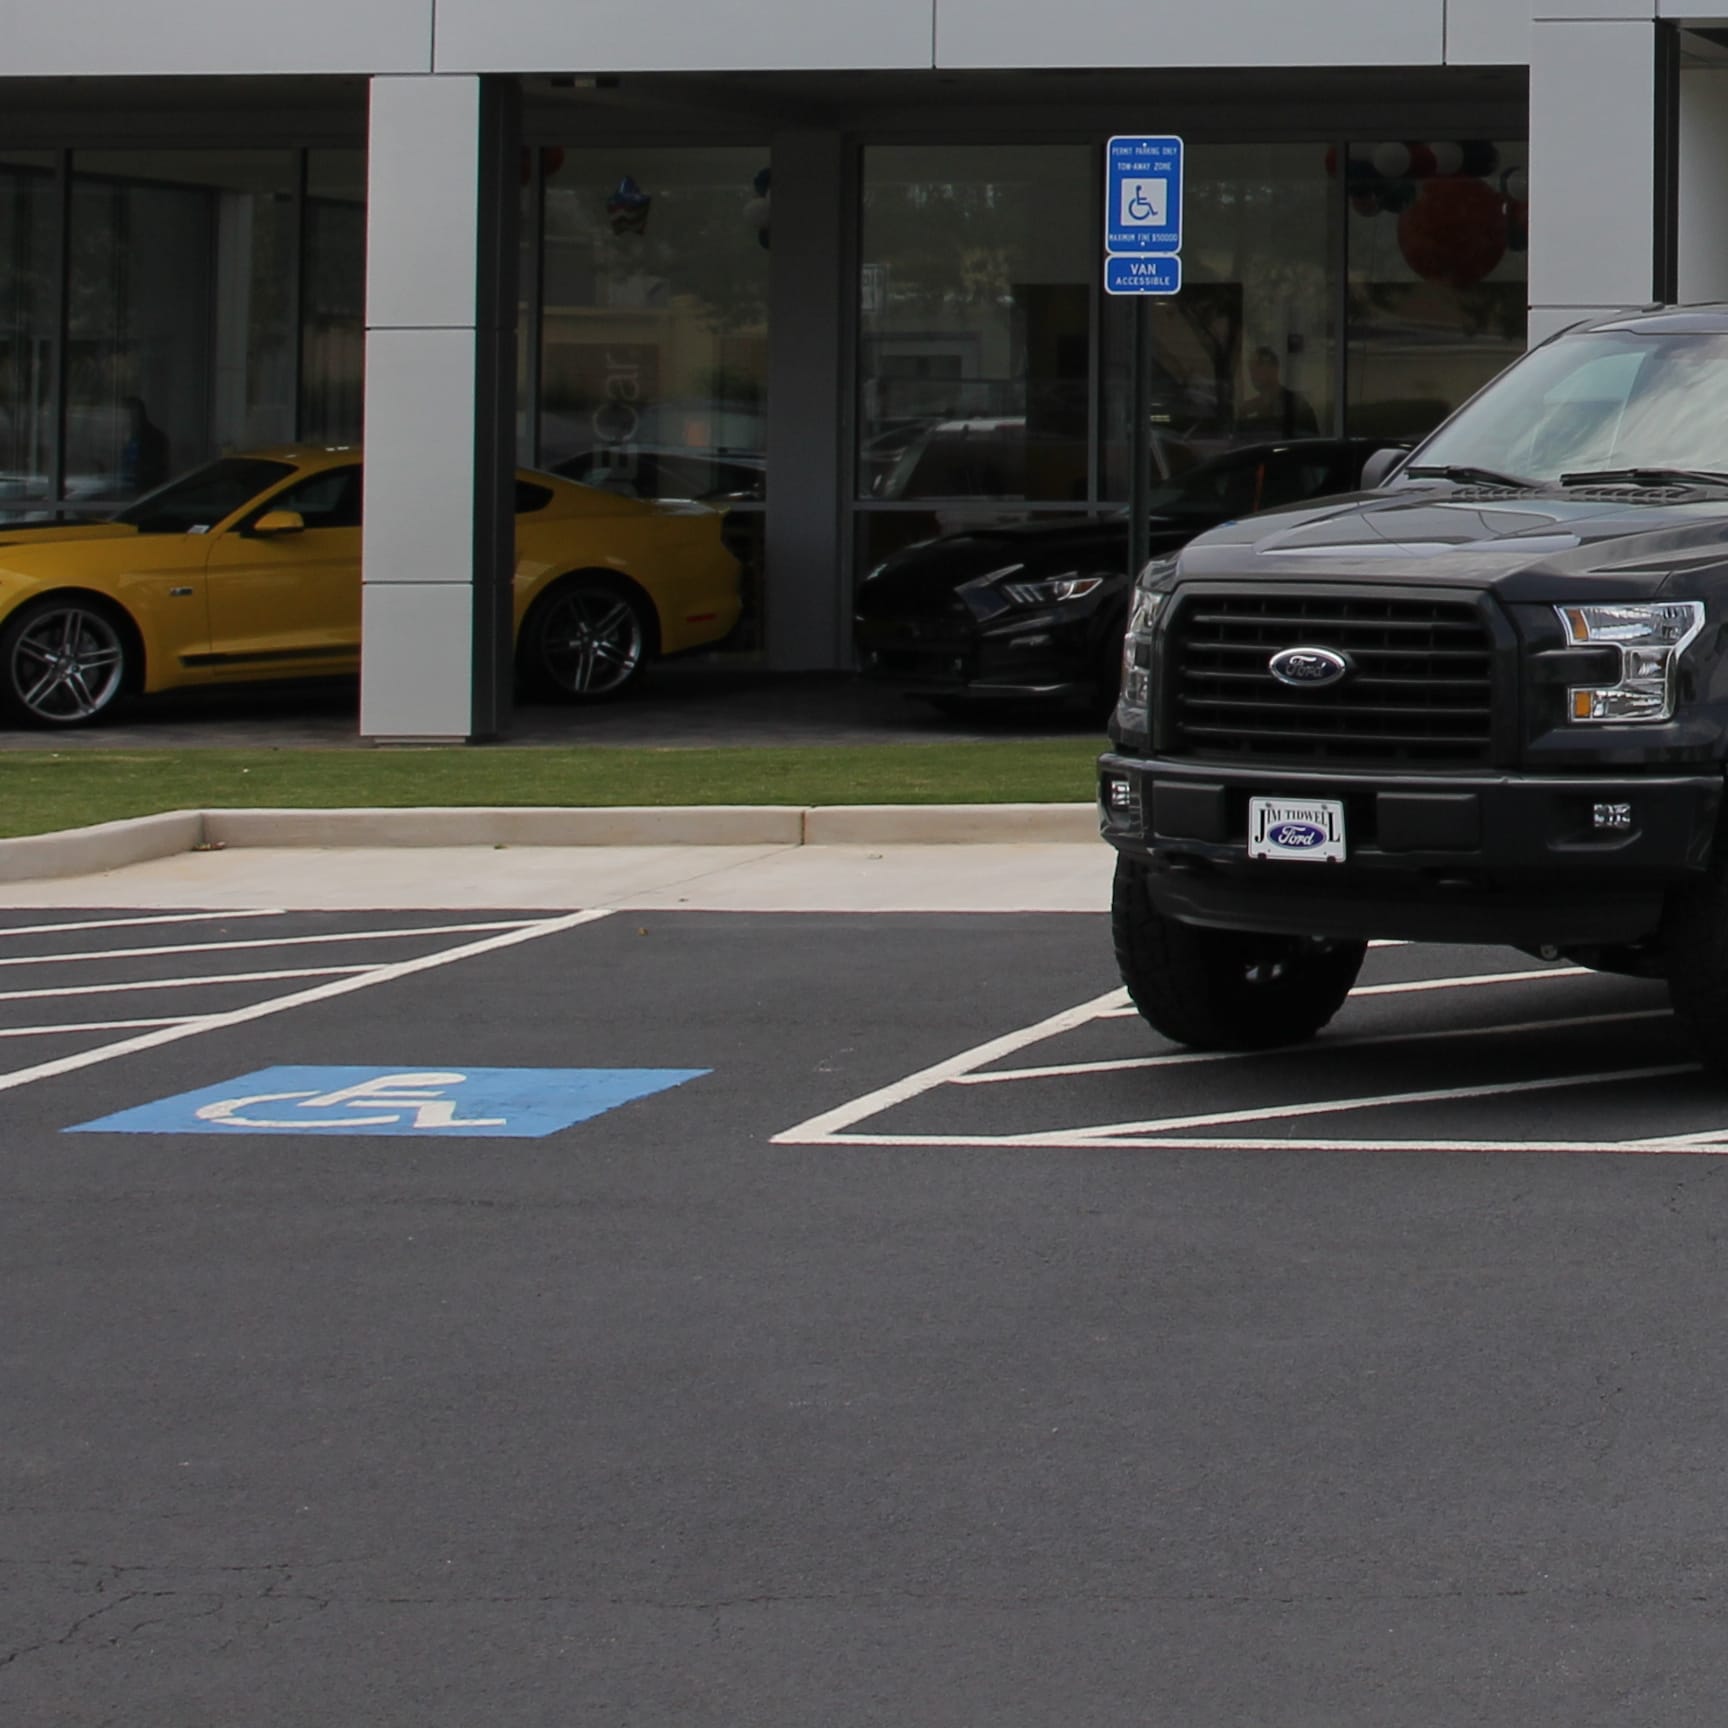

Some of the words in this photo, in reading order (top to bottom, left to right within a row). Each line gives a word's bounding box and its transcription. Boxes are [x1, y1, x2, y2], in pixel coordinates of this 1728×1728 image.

[1112, 146, 1133, 156] PERMIT
[1135, 146, 1160, 156] PARKING
[1162, 146, 1177, 156] ONLY
[1153, 161, 1172, 171] ZONE
[1109, 233, 1136, 242] MAXIMUM
[1137, 233, 1151, 242] FINE
[1130, 263, 1157, 276] VAN
[1115, 276, 1171, 286] ACCESSIBLE
[1286, 655, 1327, 677] Ford
[1254, 808, 1281, 844] JIM
[1284, 809, 1342, 843] TIDWELL
[1278, 825, 1316, 846] Ford
